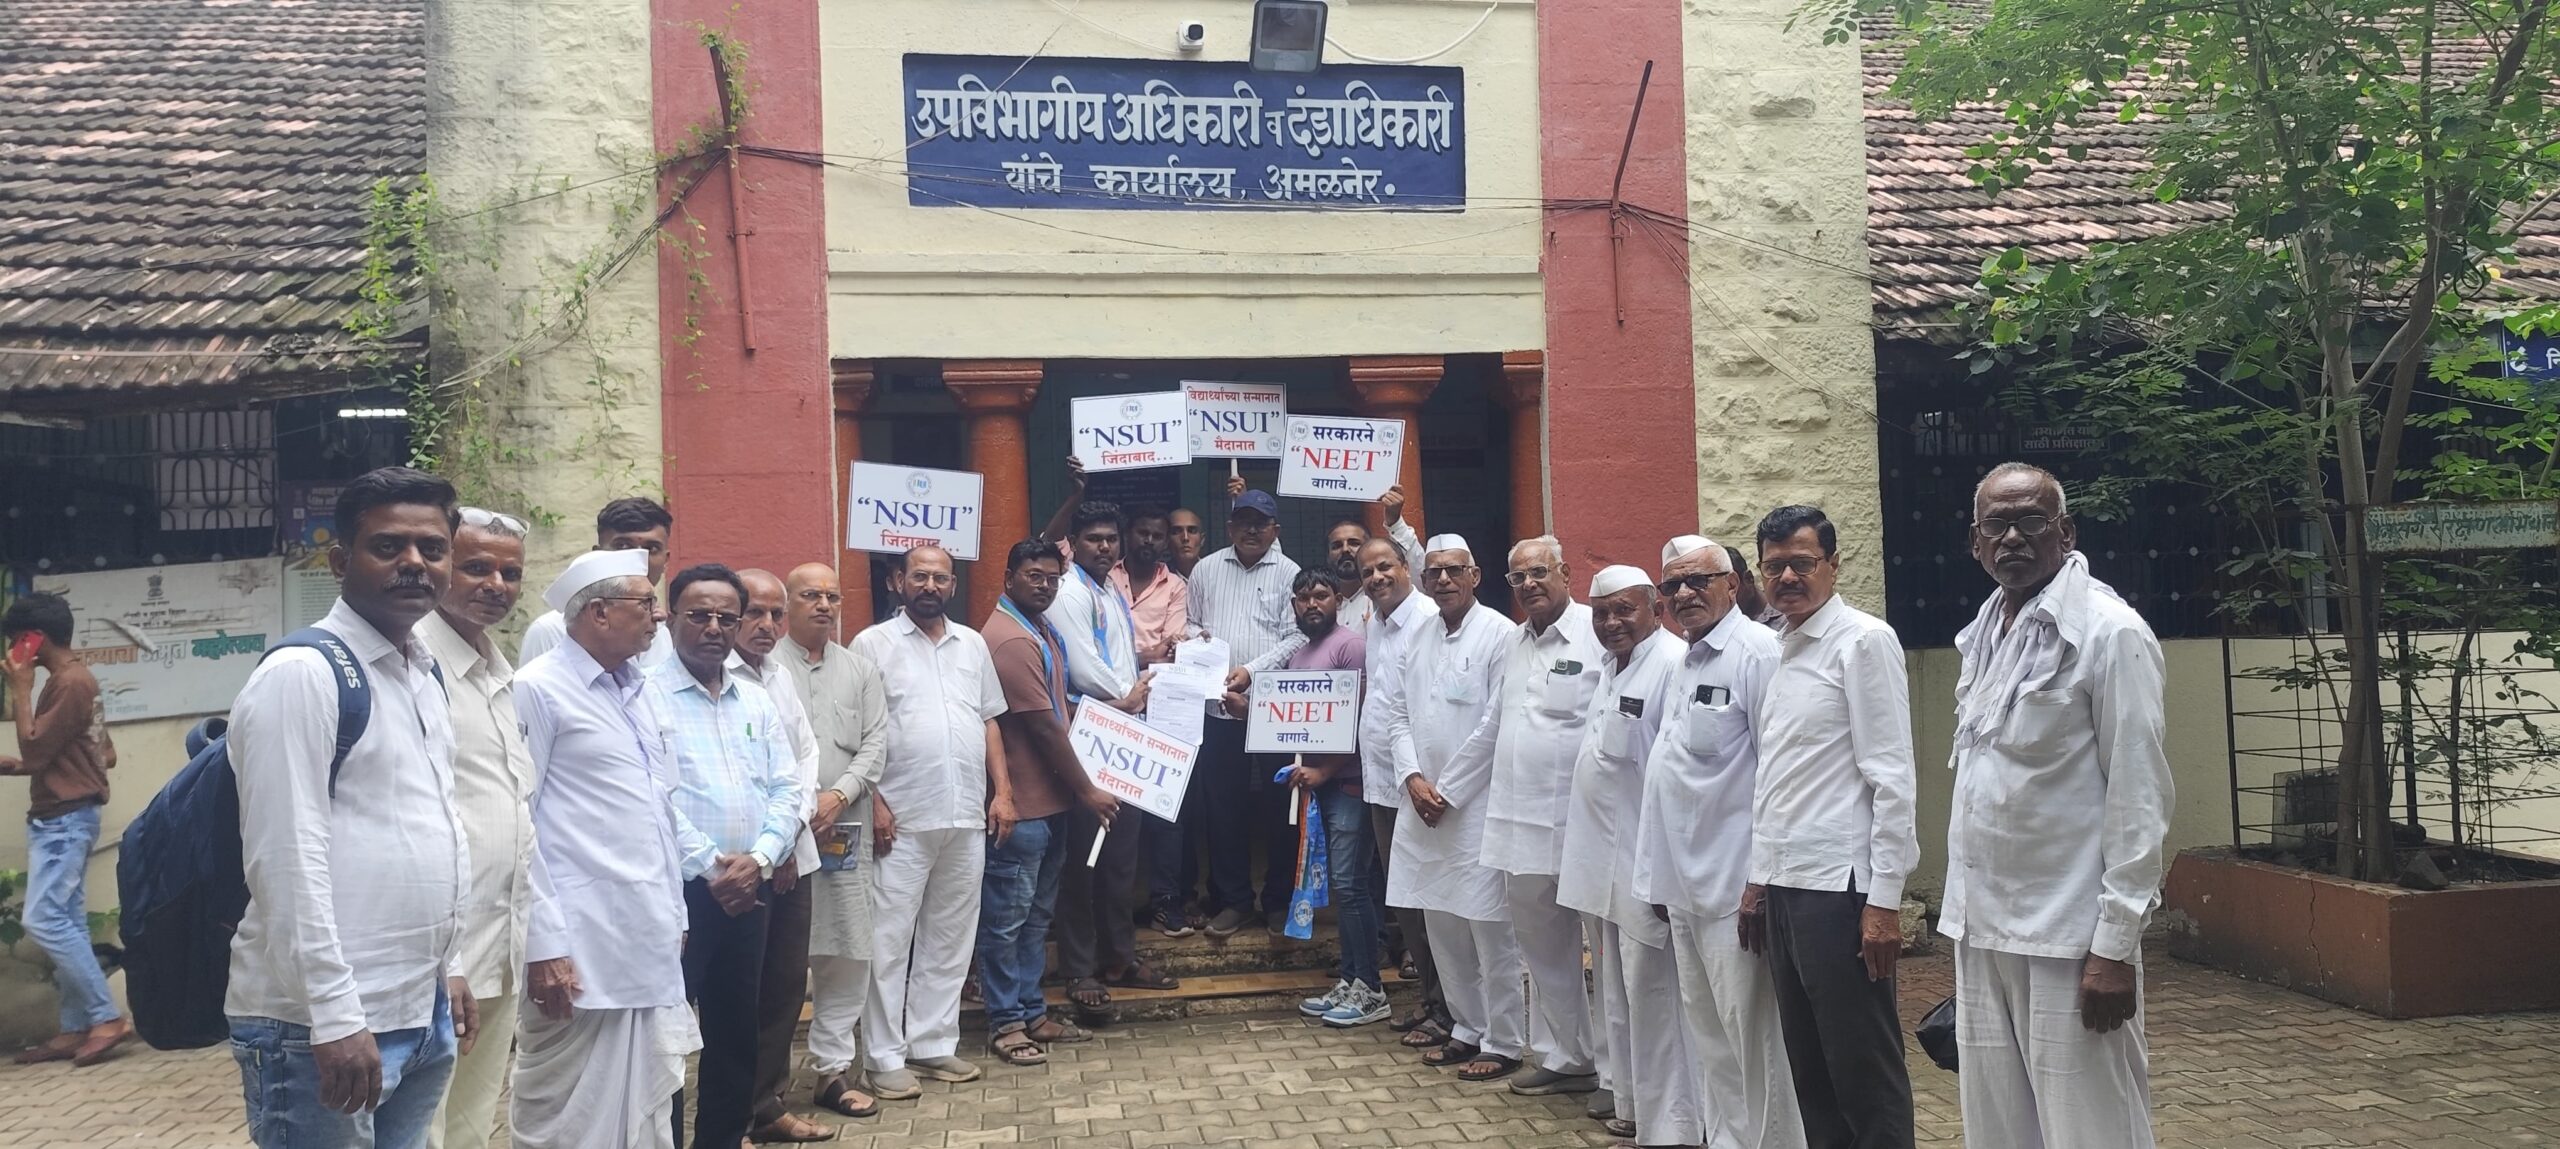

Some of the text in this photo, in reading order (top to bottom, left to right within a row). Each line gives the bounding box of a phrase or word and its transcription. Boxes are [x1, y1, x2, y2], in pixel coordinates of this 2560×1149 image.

[911, 74, 1454, 157] उपविभागीय अधिकारी व दंडाधिकारी
[1001, 152, 1064, 193] यांचे
[1079, 420, 1182, 448] “NSUI”
[1214, 435, 1255, 451] मैदानात
[1312, 422, 1375, 442] सरकारने
[2024, 436, 2050, 449] साठी
[1291, 445, 1392, 472] “NEET”
[858, 496, 973, 531] “NSUI”
[319, 640, 362, 689] safari
[1277, 673, 1334, 694] सरकारने
[1258, 700, 1350, 723] “NEET”
[1078, 728, 1183, 788] “NSUI”
[1096, 767, 1145, 799] मैदानात
